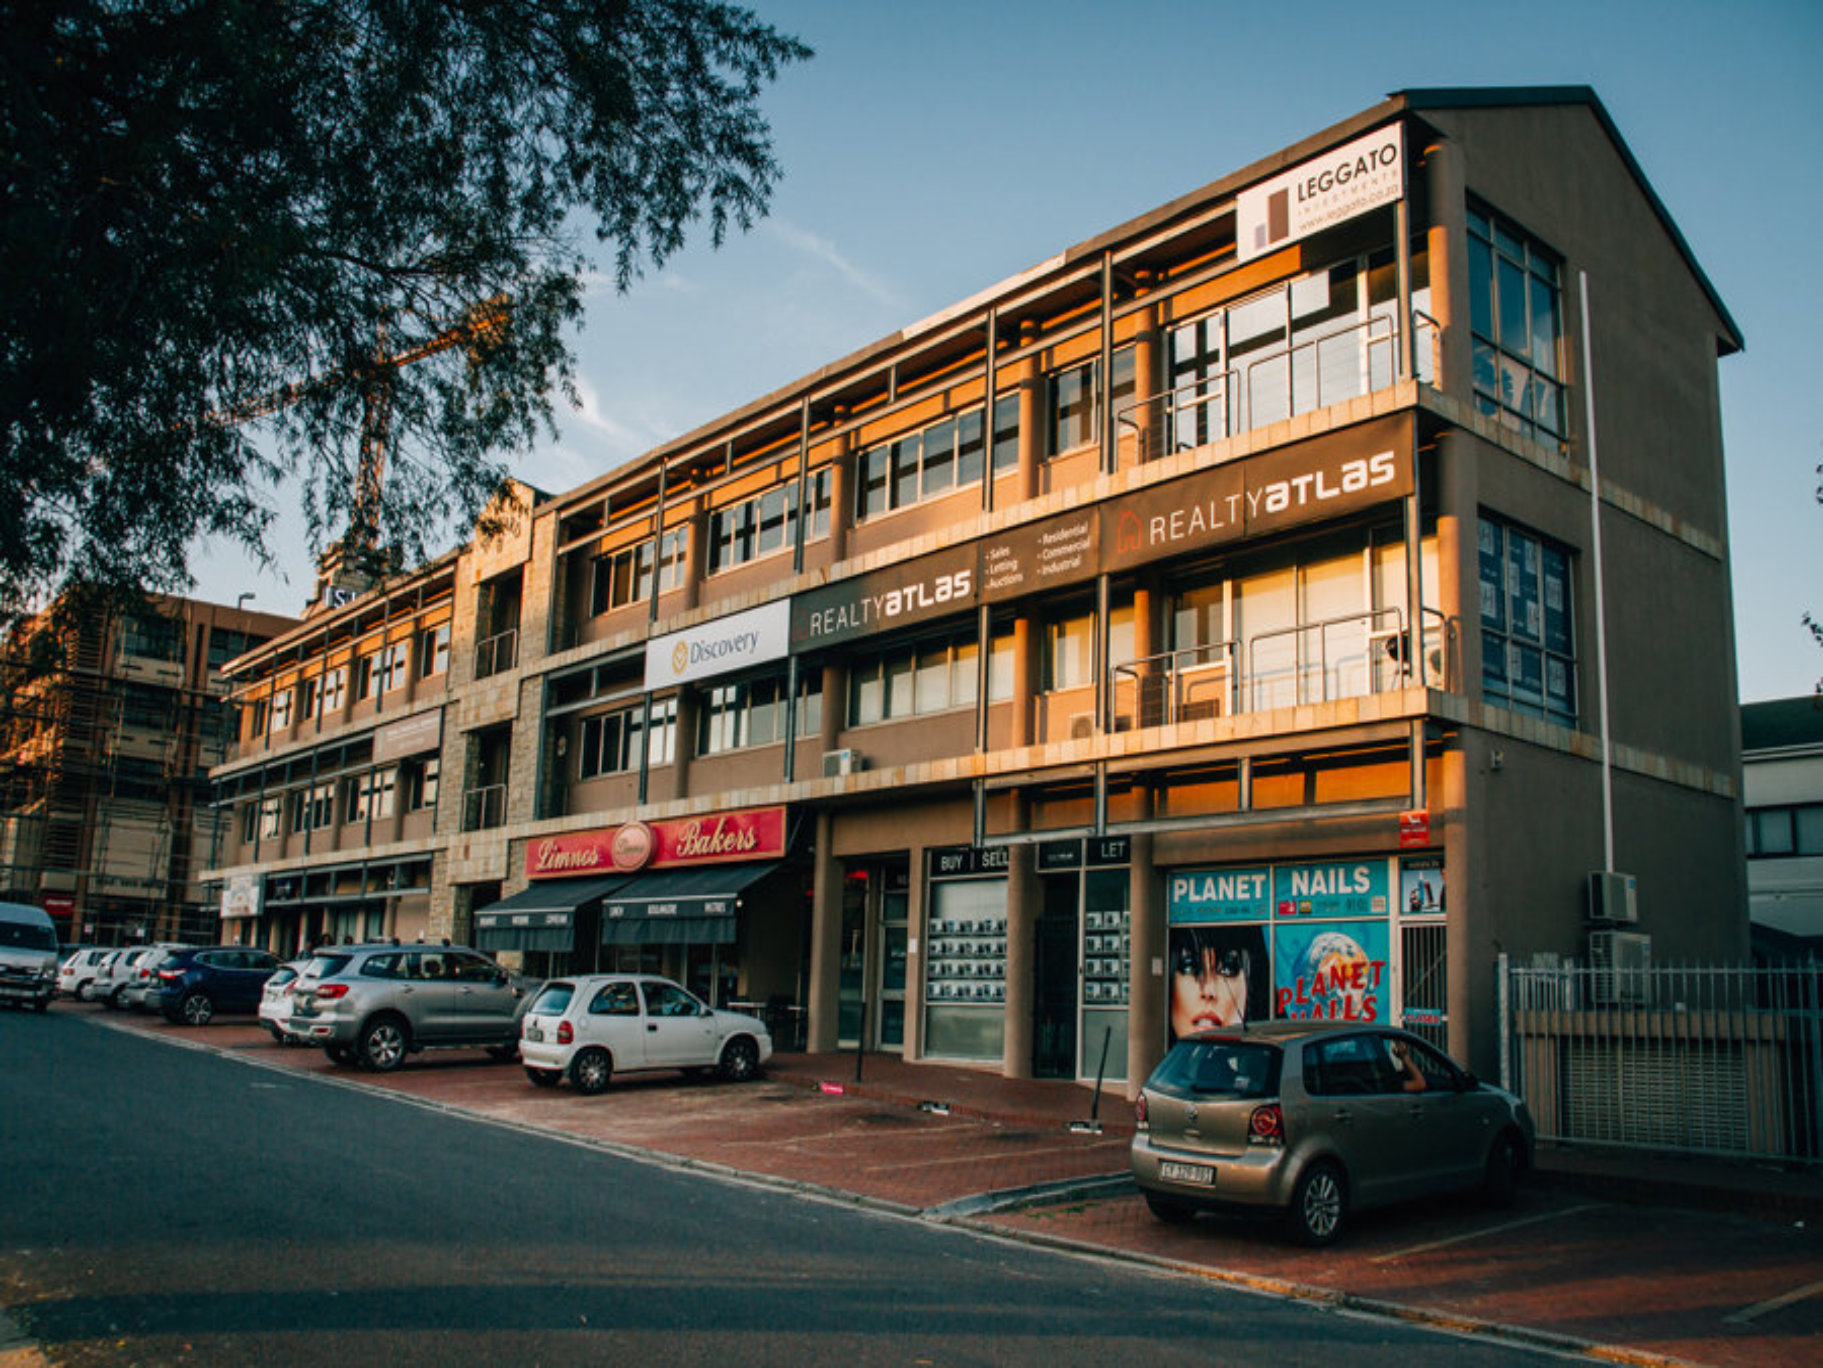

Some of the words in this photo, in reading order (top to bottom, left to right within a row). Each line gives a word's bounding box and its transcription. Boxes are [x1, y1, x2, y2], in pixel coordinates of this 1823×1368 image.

[1298, 143, 1397, 203] LEGGATO
[1042, 521, 1088, 545] Residential
[1042, 535, 1091, 560] Commercial
[990, 547, 1011, 560] Sales
[990, 560, 1018, 575] Letting
[990, 573, 1024, 588] Auctions
[690, 631, 759, 664] Discovery
[675, 817, 758, 857] Bakers
[941, 855, 963, 871] BUY
[1101, 841, 1126, 858] LET
[1173, 874, 1267, 903] PLANET
[1291, 865, 1371, 897] NAILS
[1277, 960, 1386, 1015] PLANET
